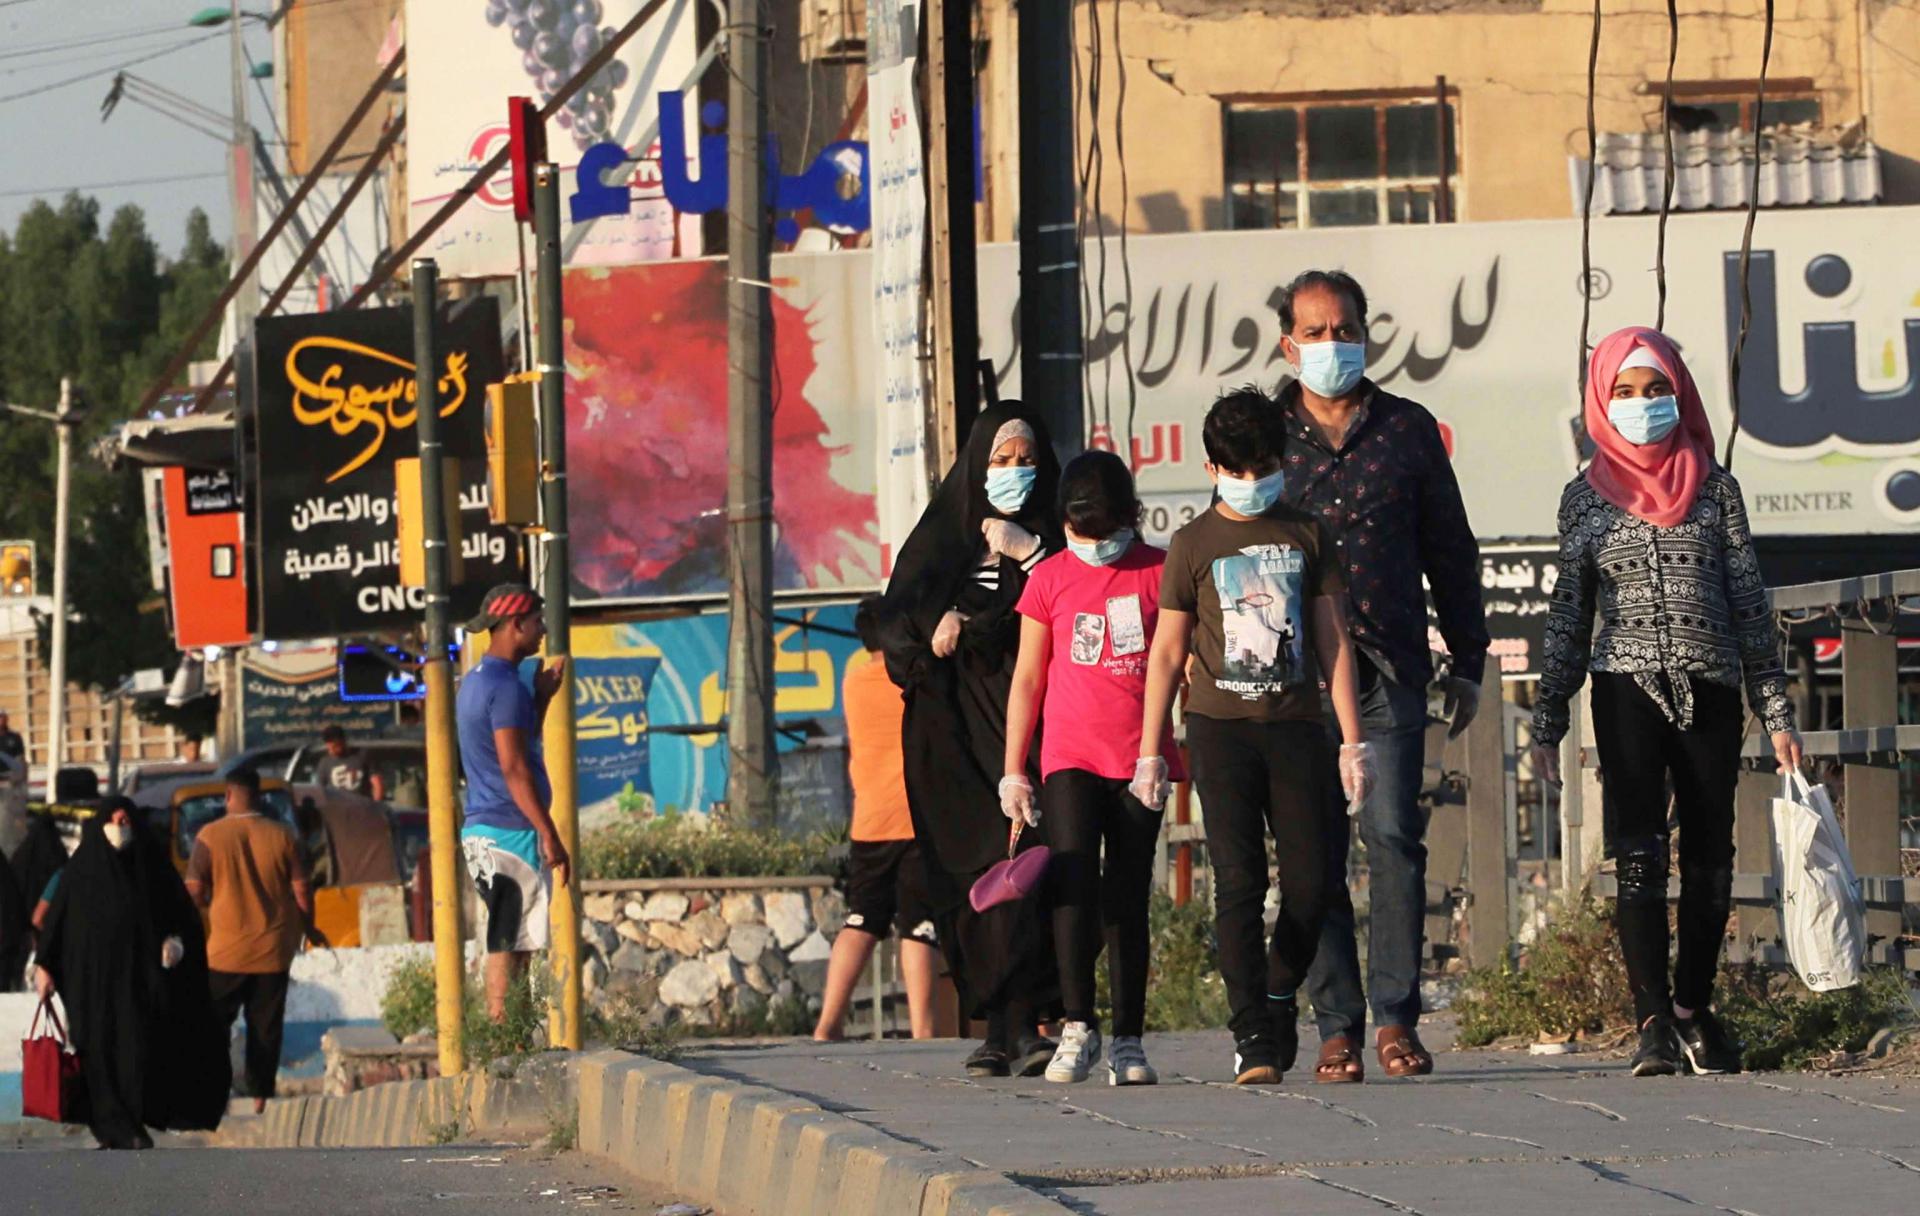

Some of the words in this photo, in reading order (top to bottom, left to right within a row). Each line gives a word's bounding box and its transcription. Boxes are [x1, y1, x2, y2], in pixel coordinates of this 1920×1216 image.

[1756, 491, 1853, 513] PRINTER
[1258, 544, 1291, 560] TRY
[576, 675, 646, 706] OKER
[1215, 679, 1282, 692] BROOKLYN
